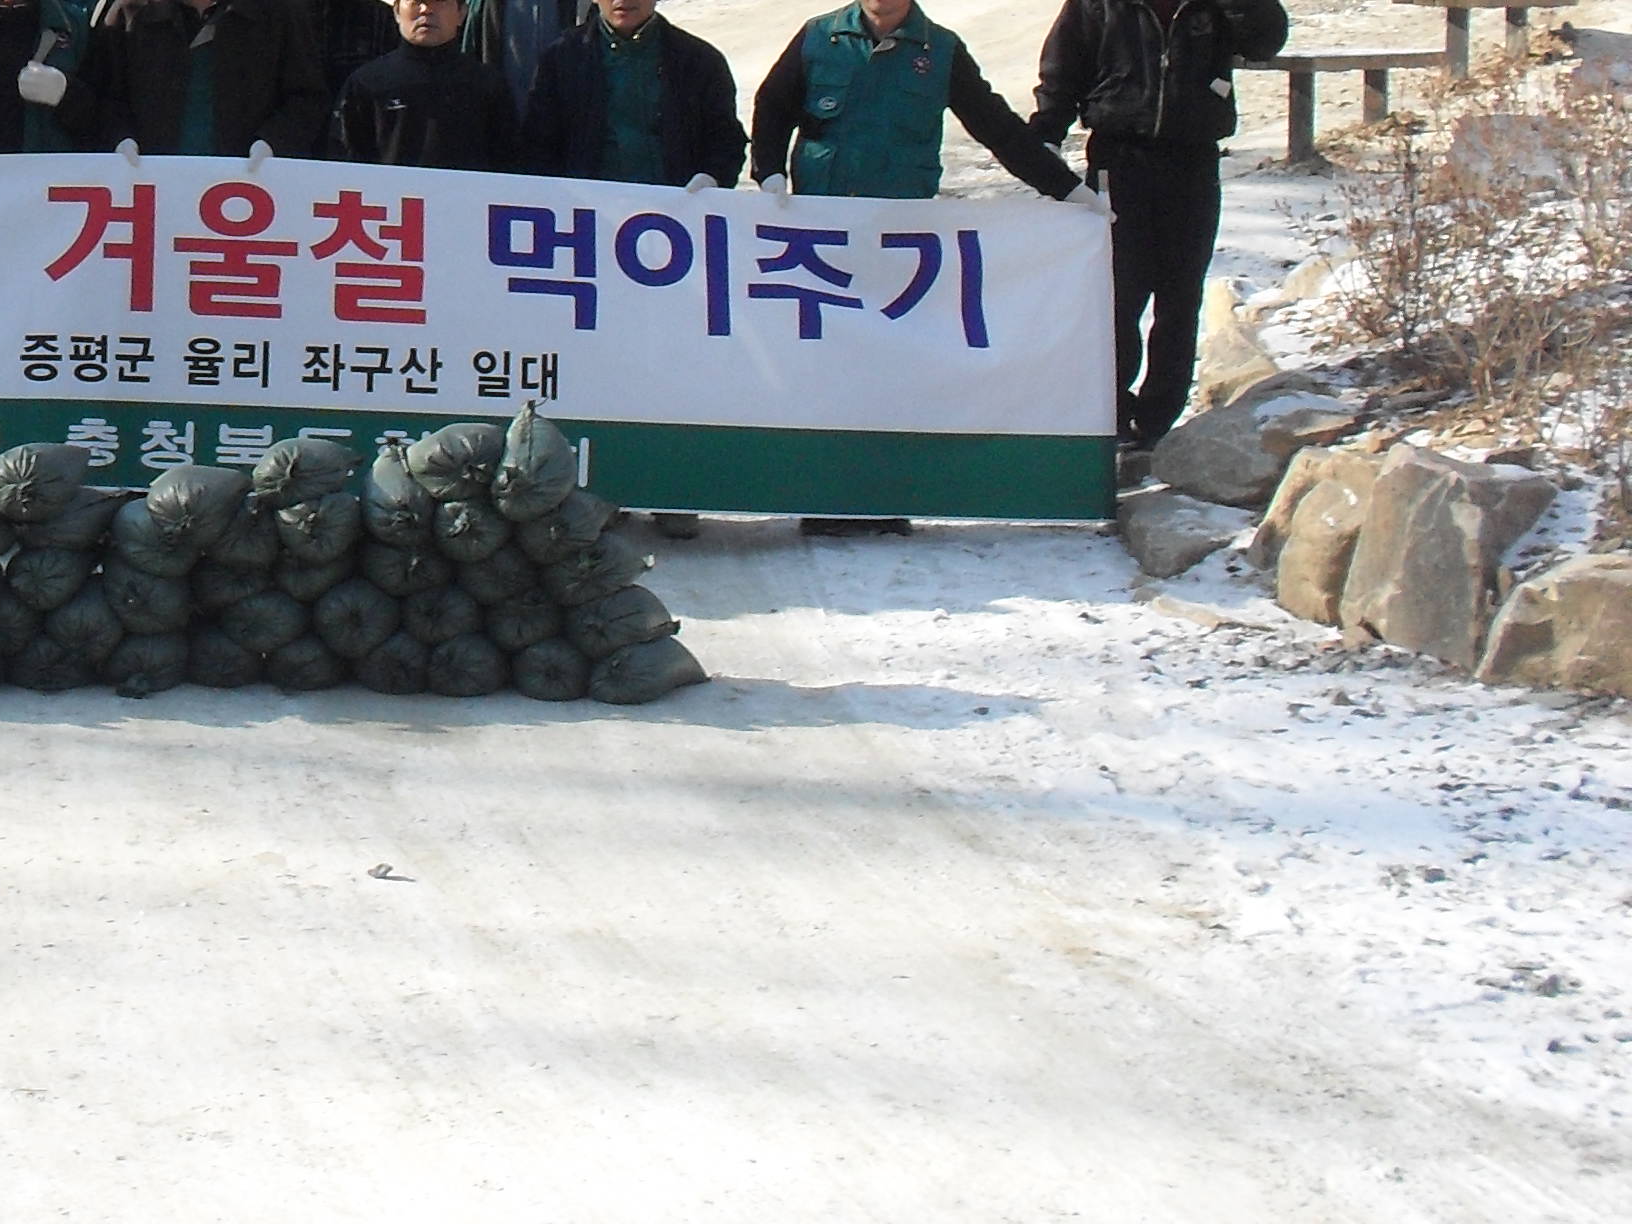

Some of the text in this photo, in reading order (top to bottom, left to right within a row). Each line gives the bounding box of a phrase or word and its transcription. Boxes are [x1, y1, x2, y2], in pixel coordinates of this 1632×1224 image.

[46, 182, 426, 324] 겨울철
[488, 204, 989, 348] 먹이주기
[20, 335, 154, 382] 증평군
[184, 338, 269, 388] 율리
[302, 344, 442, 394] 좌구산
[473, 351, 557, 402] 일대
